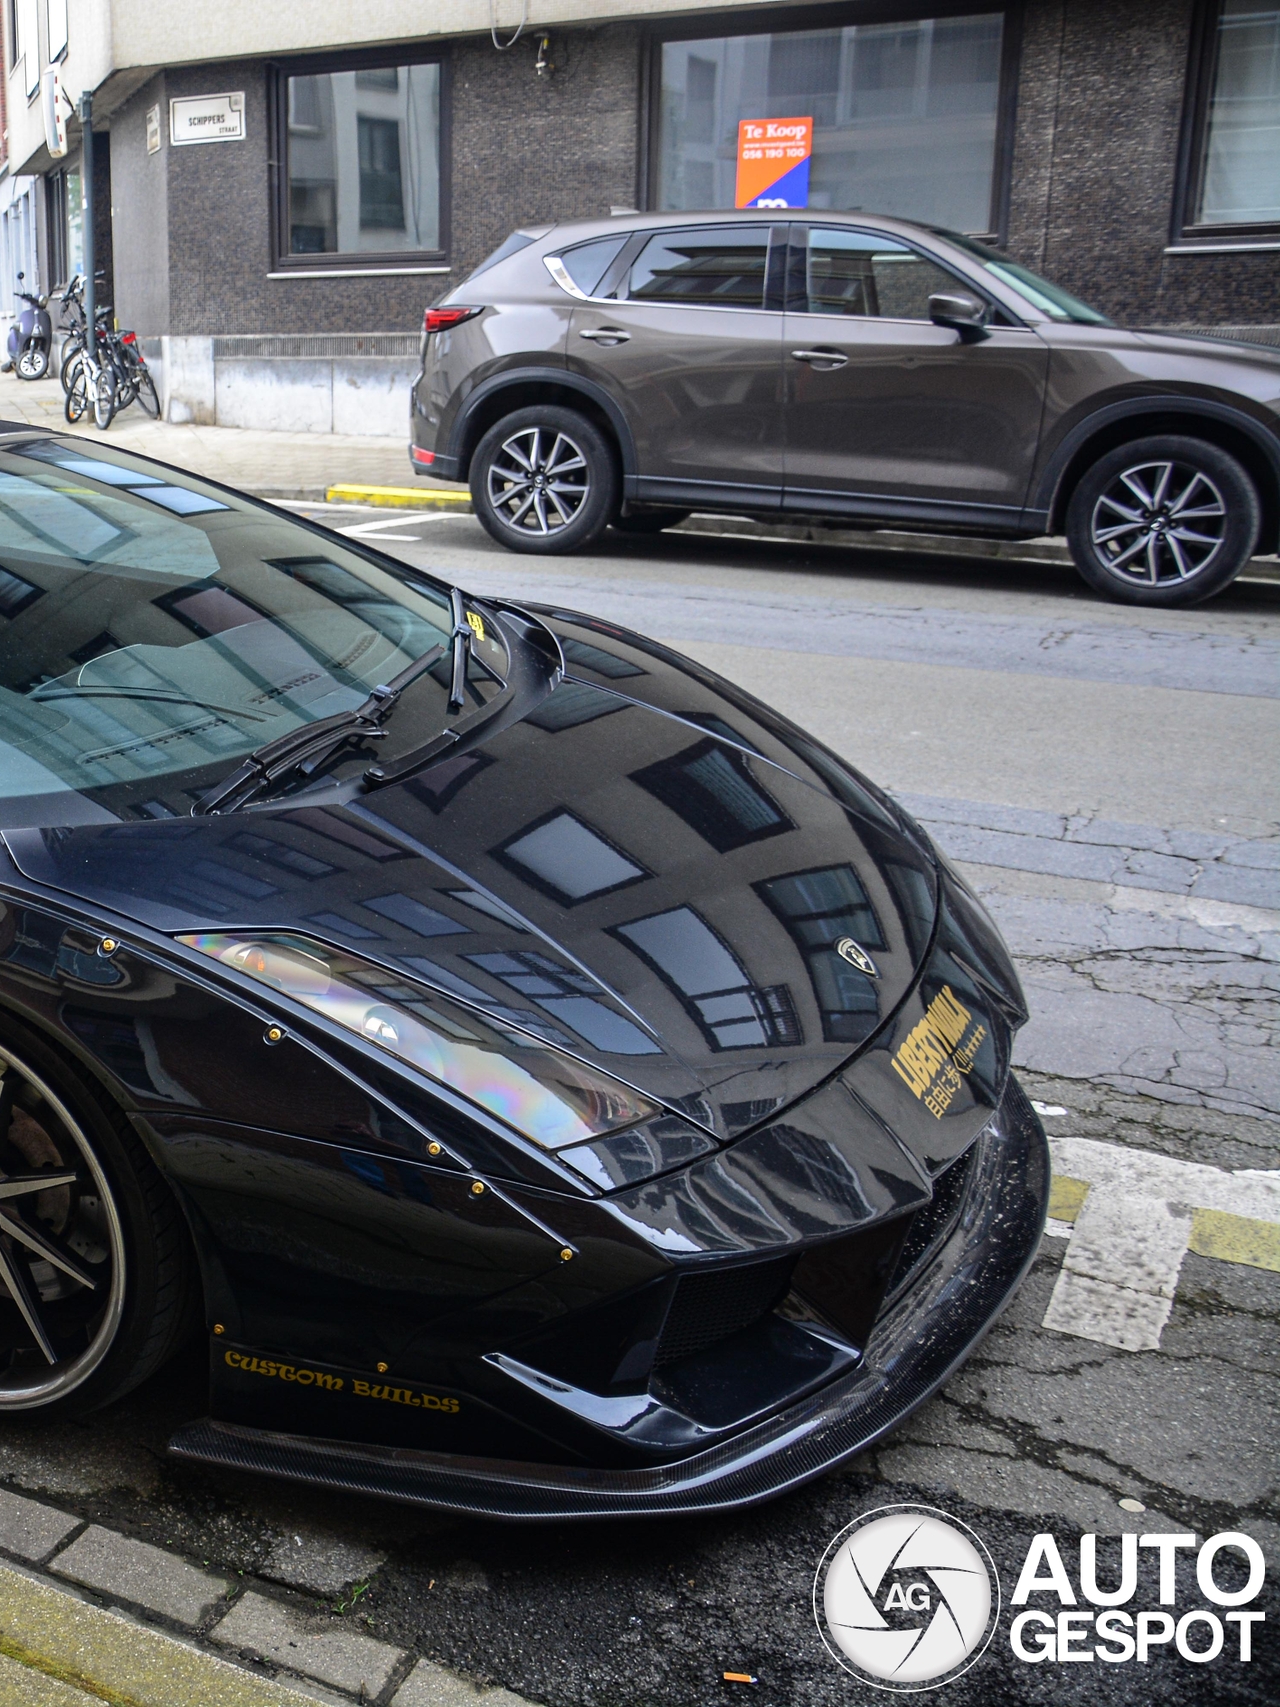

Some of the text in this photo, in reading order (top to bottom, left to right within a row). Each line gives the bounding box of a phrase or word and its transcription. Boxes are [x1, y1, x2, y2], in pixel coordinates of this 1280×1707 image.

[188, 114, 225, 127] SCHIPPERS
[219, 126, 238, 134] STRAAT
[743, 124, 807, 140] Te Koop
[742, 148, 805, 160] 056 190 100
[224, 1350, 460, 1414] CUSTOM BUILDS
